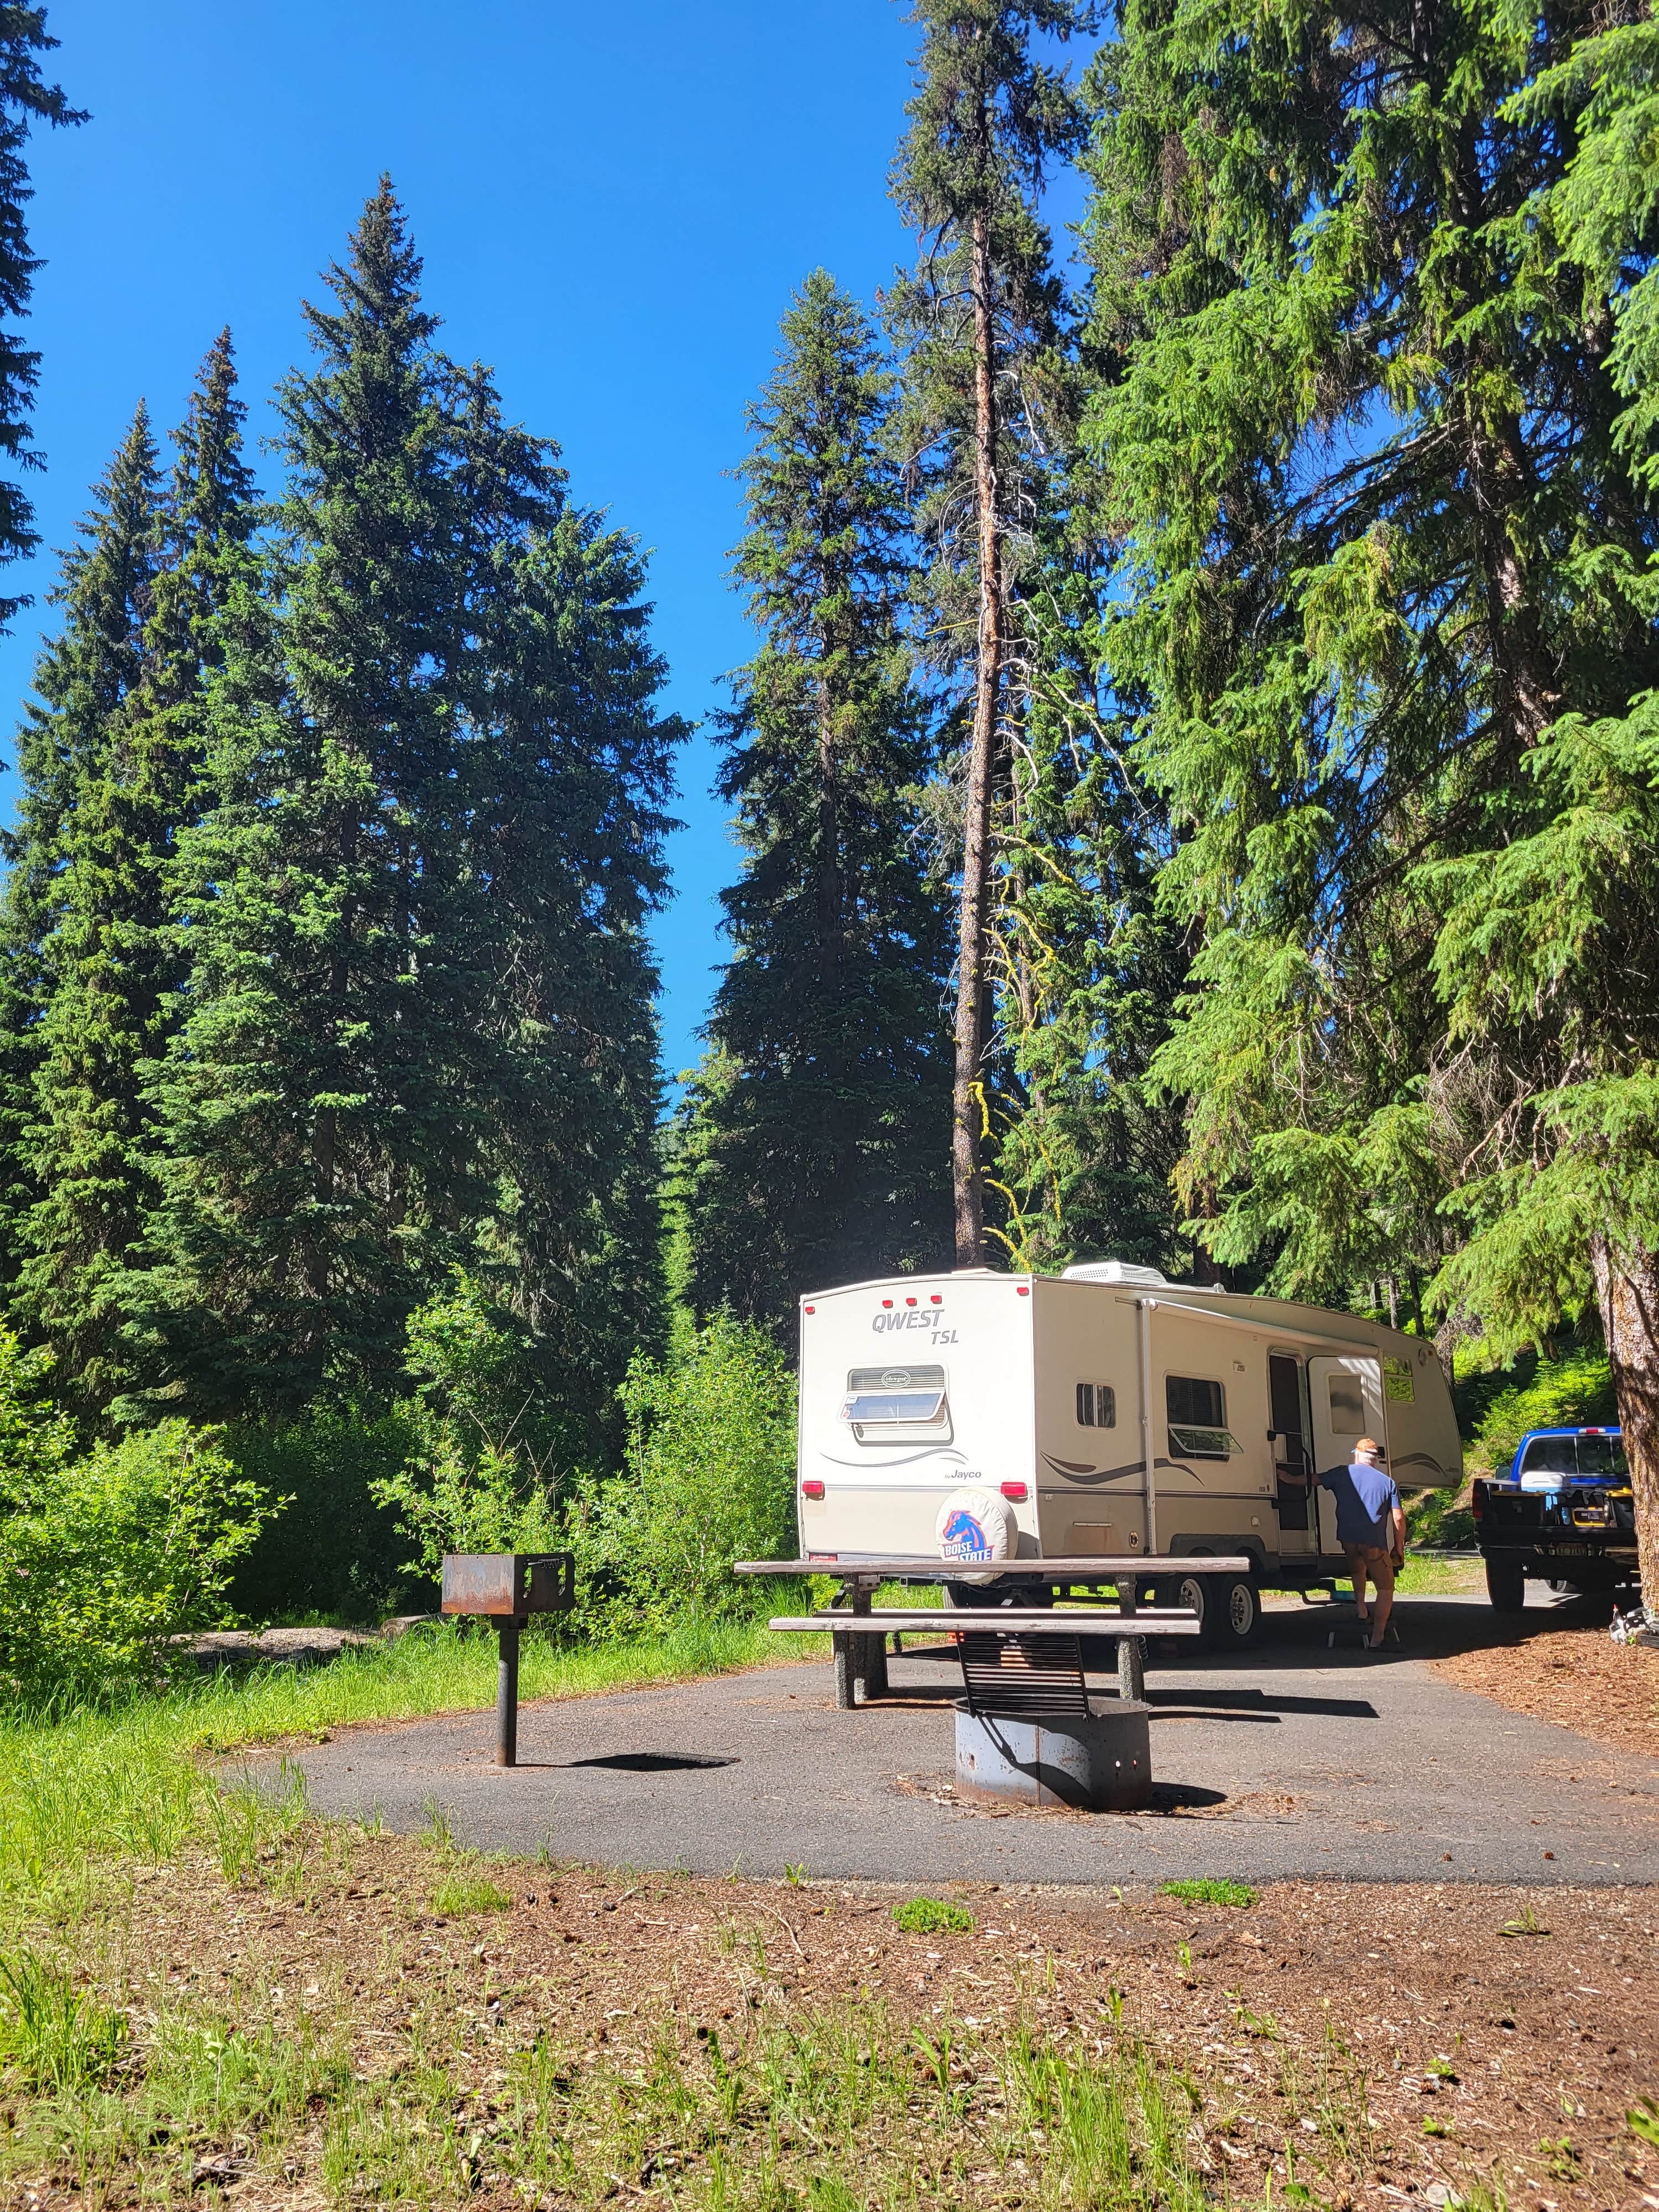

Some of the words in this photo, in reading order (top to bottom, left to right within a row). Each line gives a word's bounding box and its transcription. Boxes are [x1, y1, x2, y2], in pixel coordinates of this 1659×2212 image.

[872, 1309, 945, 1333] QWEST
[931, 1330, 959, 1344] TSL
[951, 1469, 982, 1480] Jayco
[945, 1541, 973, 1556] BOISE
[959, 1548, 991, 1562] STATE
